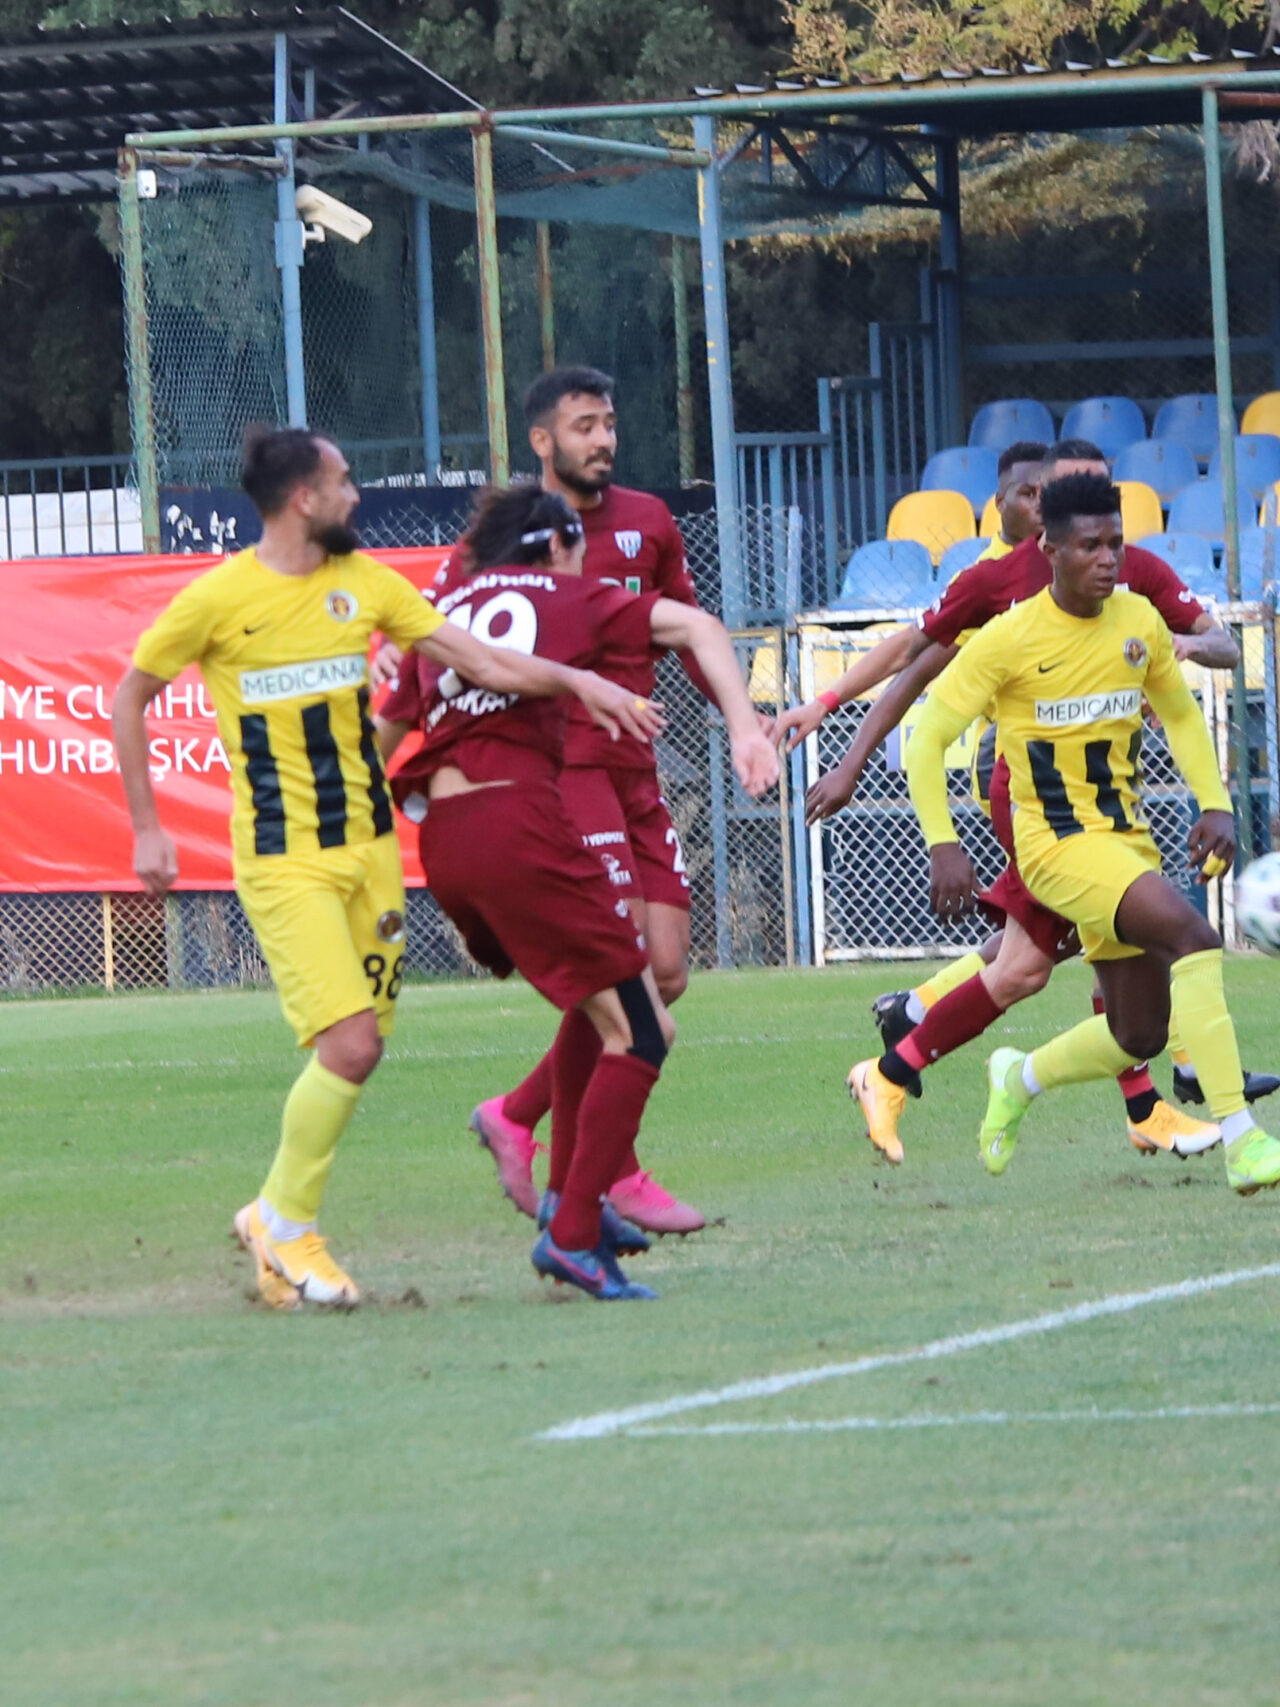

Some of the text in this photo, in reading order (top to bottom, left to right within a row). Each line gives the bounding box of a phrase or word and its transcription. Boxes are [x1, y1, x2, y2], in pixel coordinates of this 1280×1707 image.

[244, 661, 366, 697] MEDICANA
[1036, 690, 1140, 722] MEDICANA
[0, 737, 232, 782] HURBŞKA
